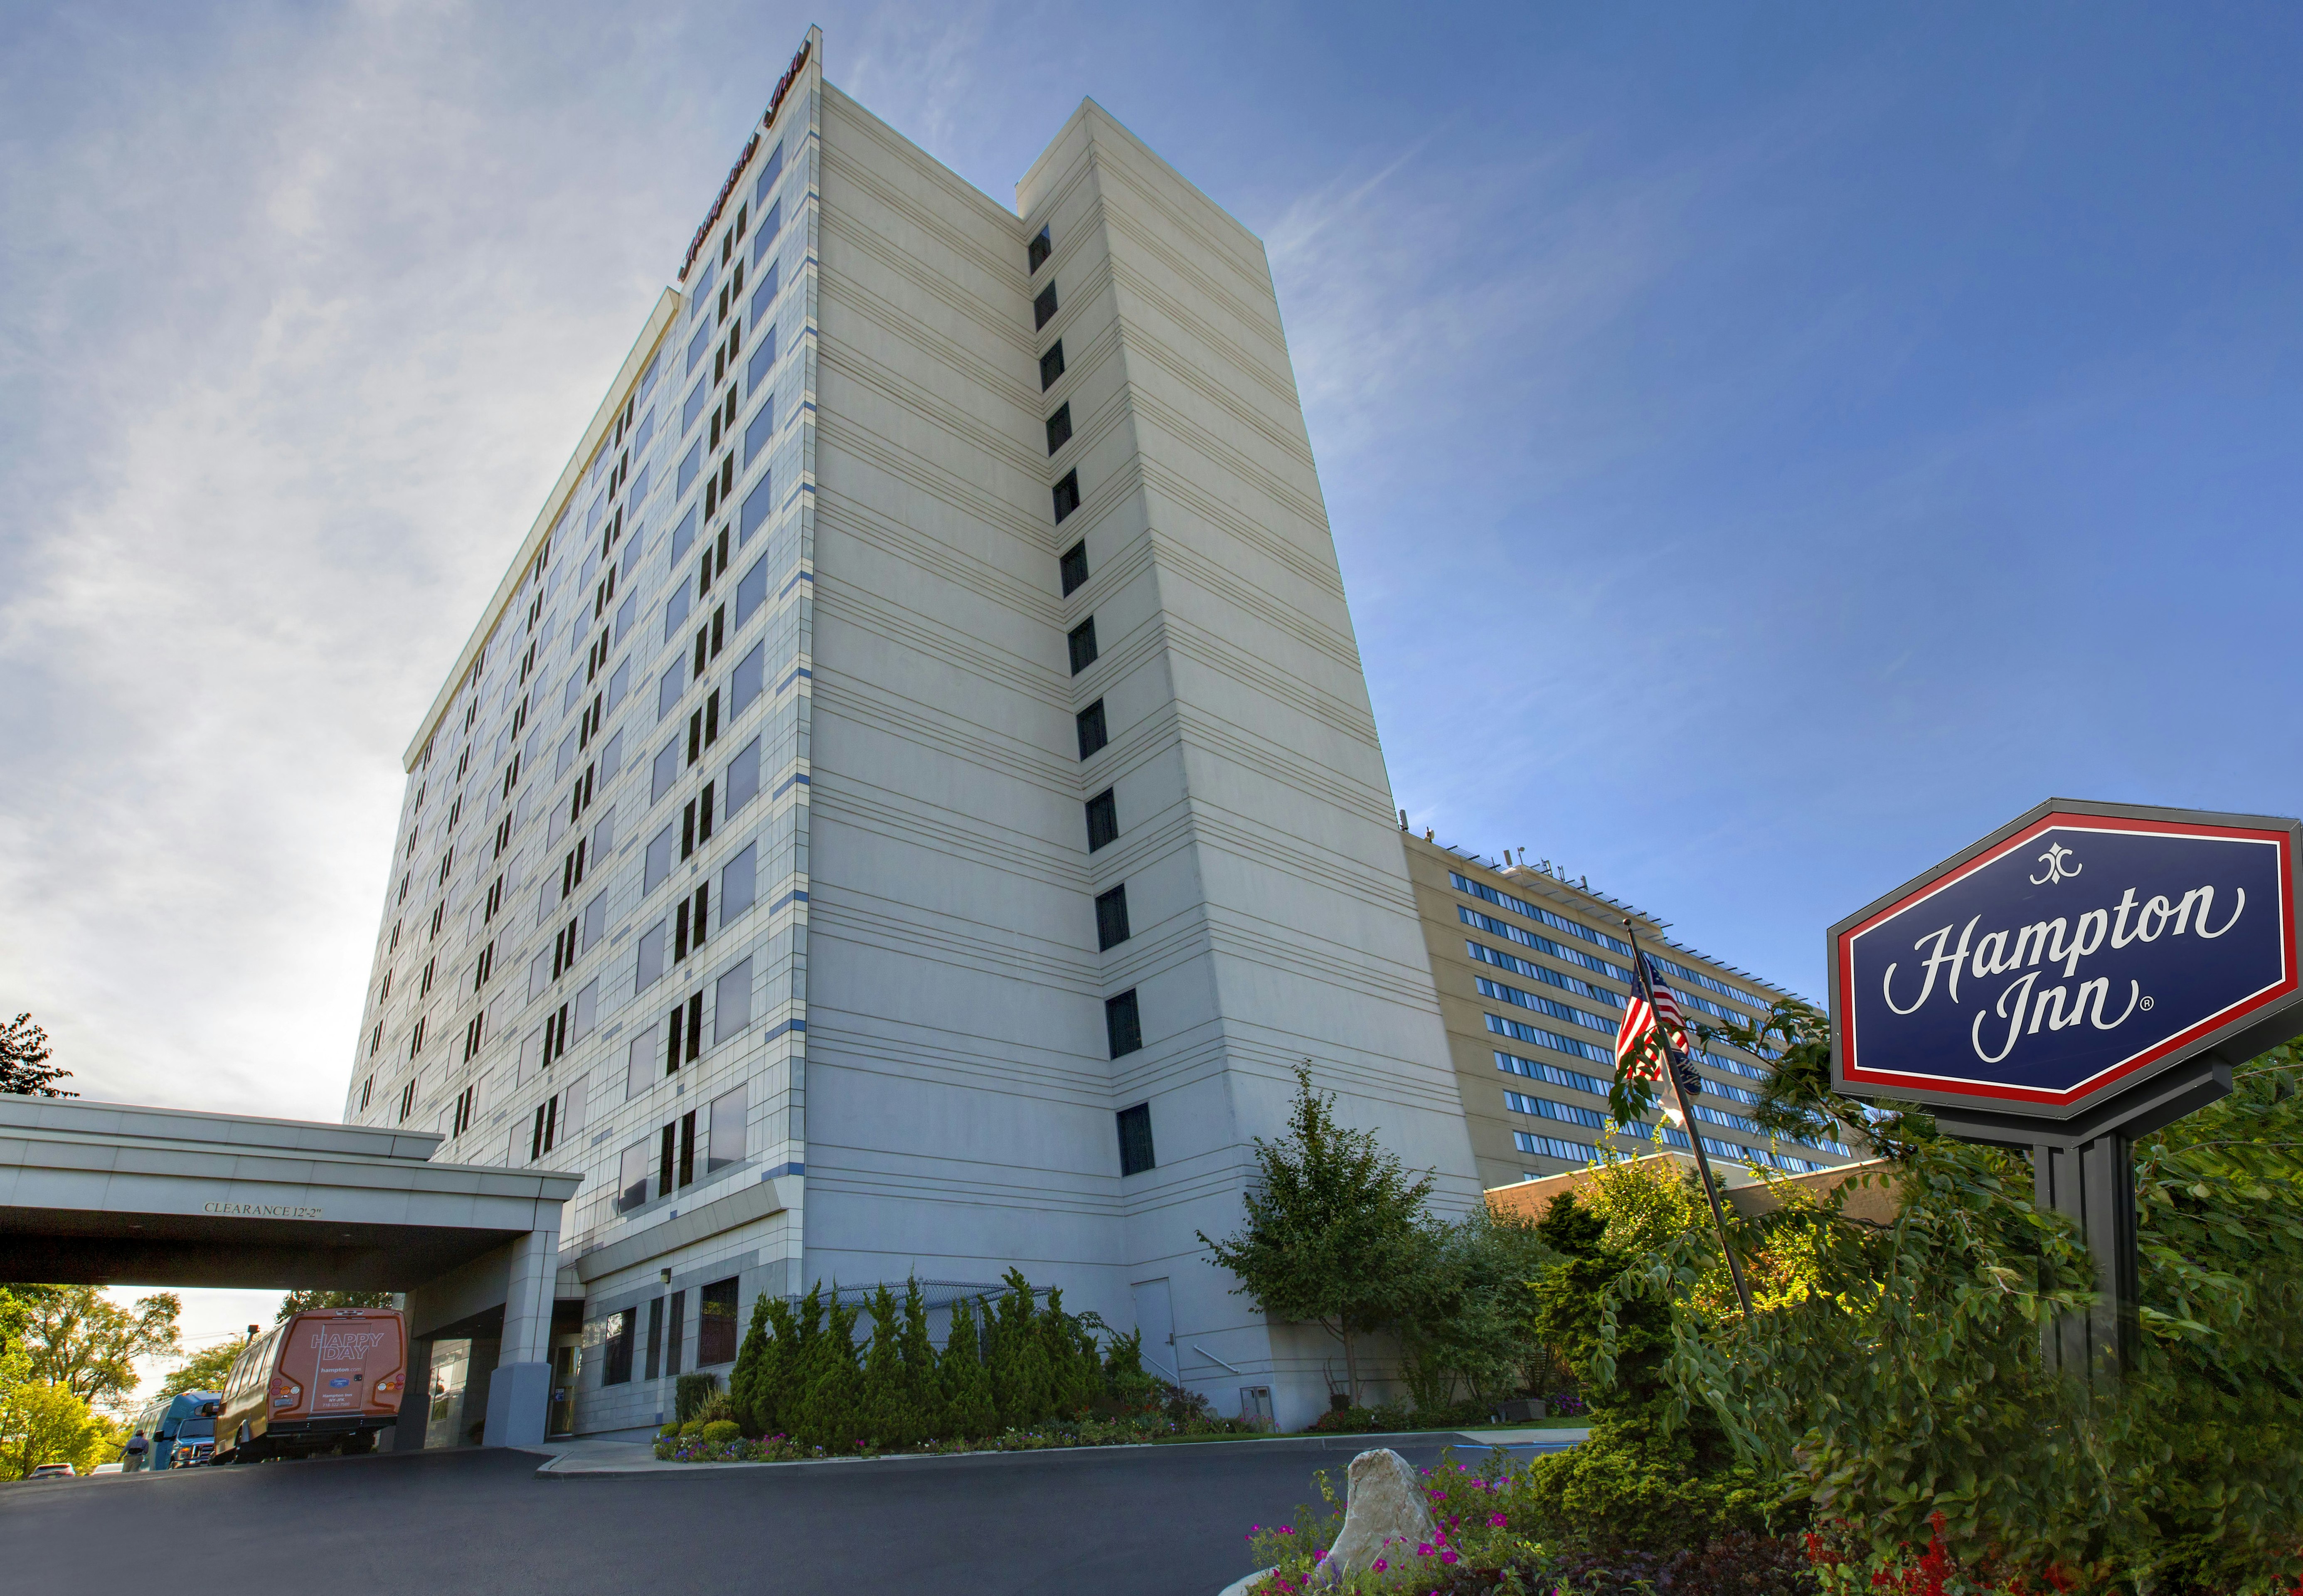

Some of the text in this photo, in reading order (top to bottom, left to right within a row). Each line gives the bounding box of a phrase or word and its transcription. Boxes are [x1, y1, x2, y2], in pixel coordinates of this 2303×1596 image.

[1883, 884, 2245, 1015] Hampton
[1972, 971, 2140, 1063] Inn
[205, 1202, 321, 1217] CLEARANCE 12'-2"
[311, 1333, 384, 1348] HAPPY
[323, 1346, 369, 1360] DAY
